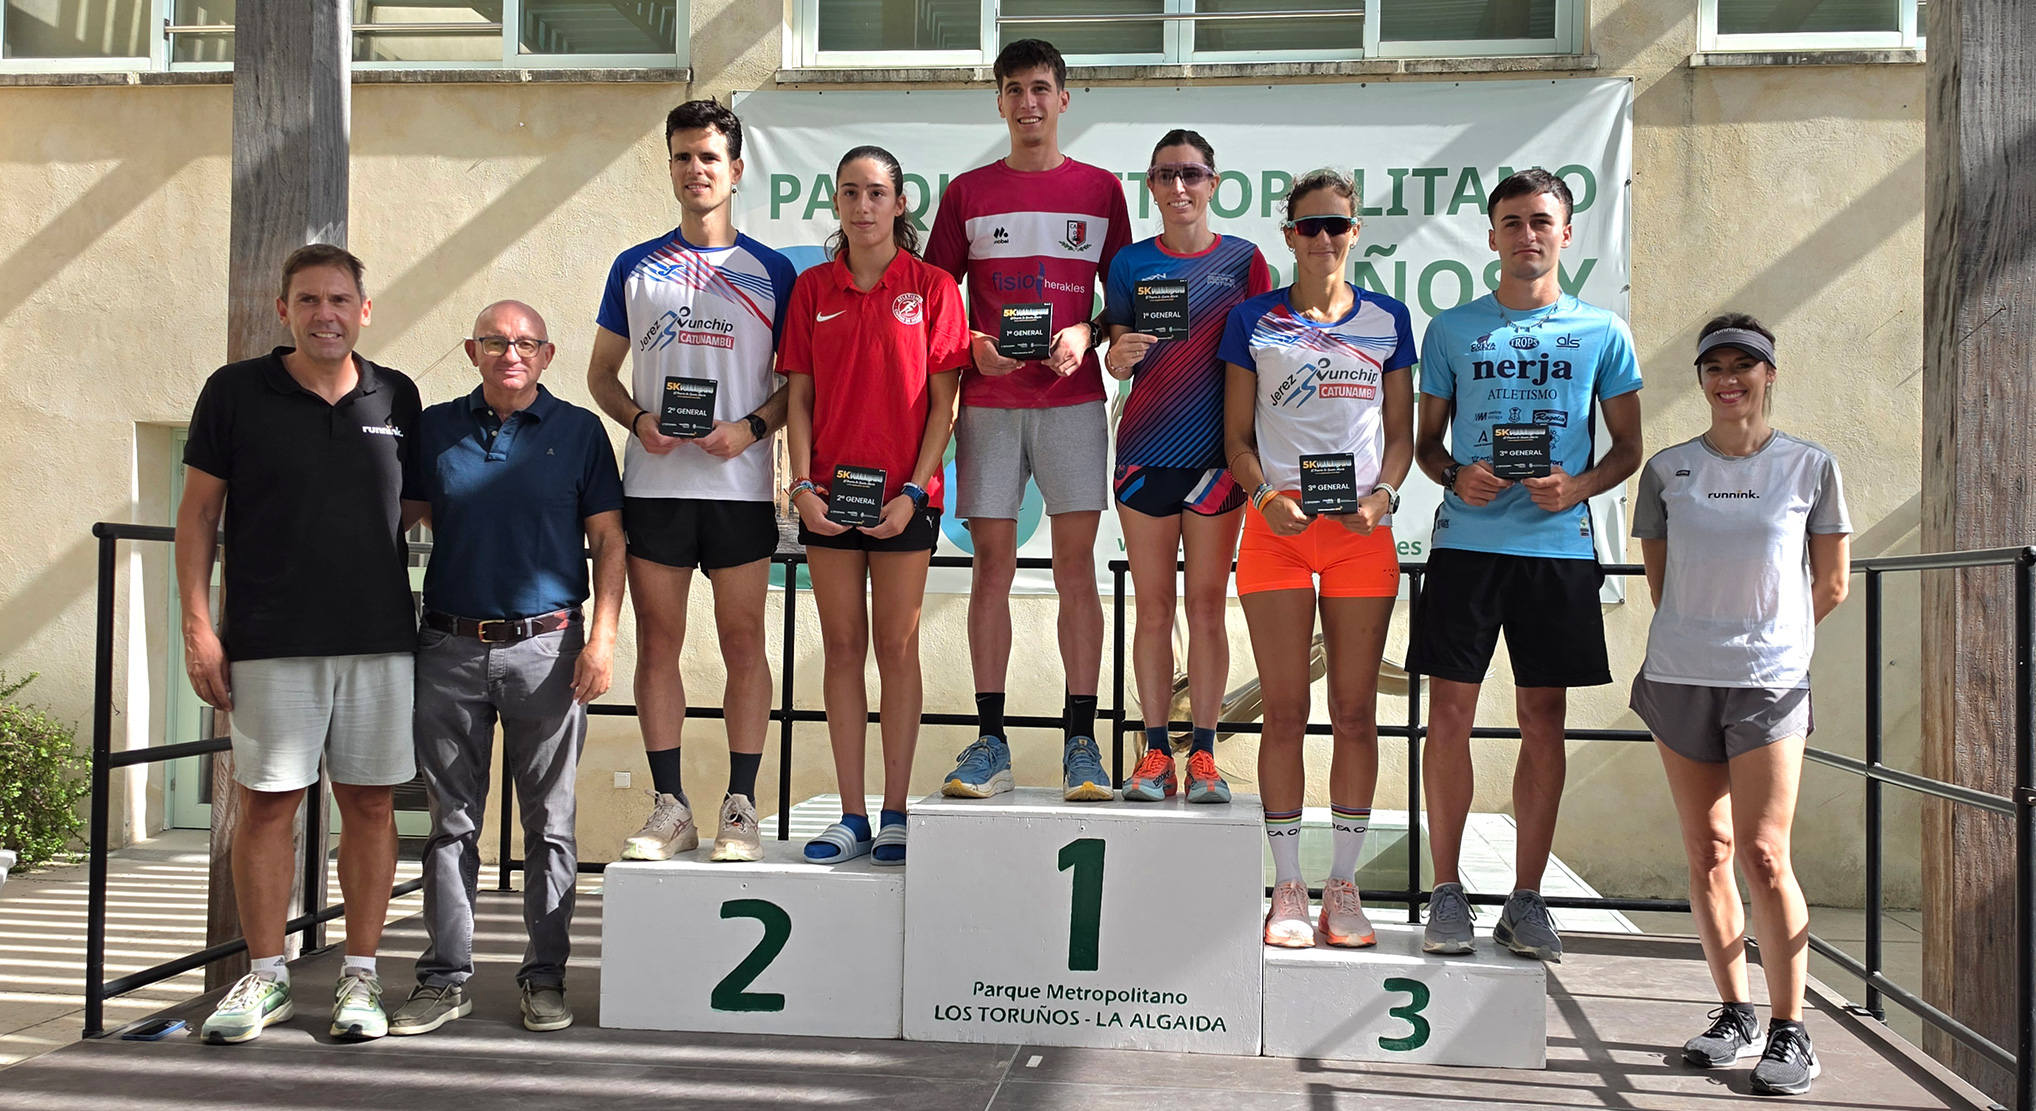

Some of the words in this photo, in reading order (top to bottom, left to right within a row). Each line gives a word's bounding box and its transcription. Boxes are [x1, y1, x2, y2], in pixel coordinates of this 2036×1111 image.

[992, 271, 1035, 291] fisio
[1044, 279, 1085, 294] herakles
[1150, 311, 1182, 319] GENERAL
[639, 320, 661, 352] Jerez
[1013, 329, 1044, 337] GENERAL
[1511, 337, 1539, 348] TROPS
[1556, 333, 1581, 348] als
[1472, 353, 1573, 386] nerja
[1270, 373, 1297, 407] Jerez
[1488, 389, 1557, 401] ATLETISMO
[676, 407, 707, 417] GENERAL
[1317, 483, 1350, 491] GENERAL
[1707, 489, 1760, 499] runnink.
[845, 495, 876, 506] GENERAL
[1058, 838, 1106, 971] 1
[710, 898, 792, 1013] 2
[973, 981, 1041, 1002] Parque
[1046, 983, 1188, 1006] Metropolitano
[934, 1004, 972, 1021] LOS
[978, 1005, 1080, 1026] TORUÑOS
[1096, 1011, 1123, 1028] LA
[1129, 1013, 1227, 1033] ALGAIDA
[1378, 977, 1431, 1052] 3
